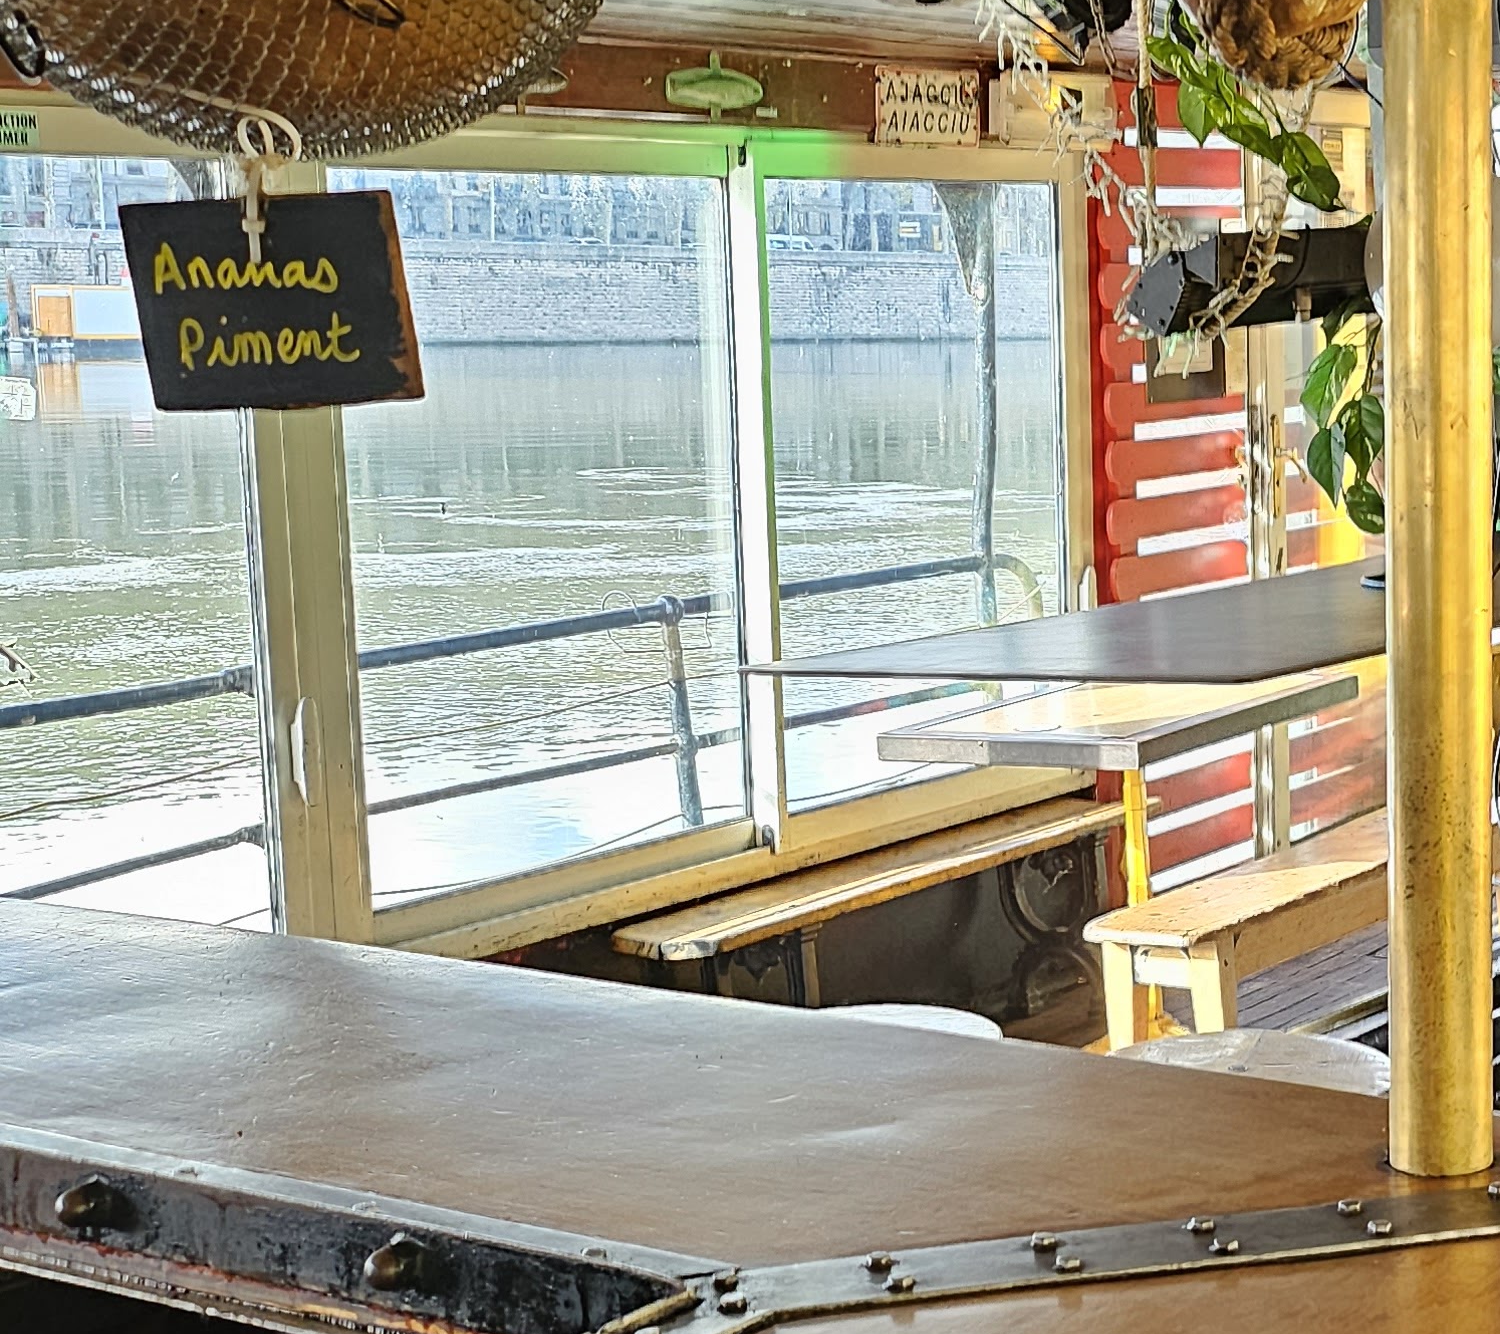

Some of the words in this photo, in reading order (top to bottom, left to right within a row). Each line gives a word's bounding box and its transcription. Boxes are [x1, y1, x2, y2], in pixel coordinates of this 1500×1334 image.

[888, 110, 970, 134] AIACCIU
[155, 242, 338, 294] Ananas
[180, 311, 360, 370] Piment
